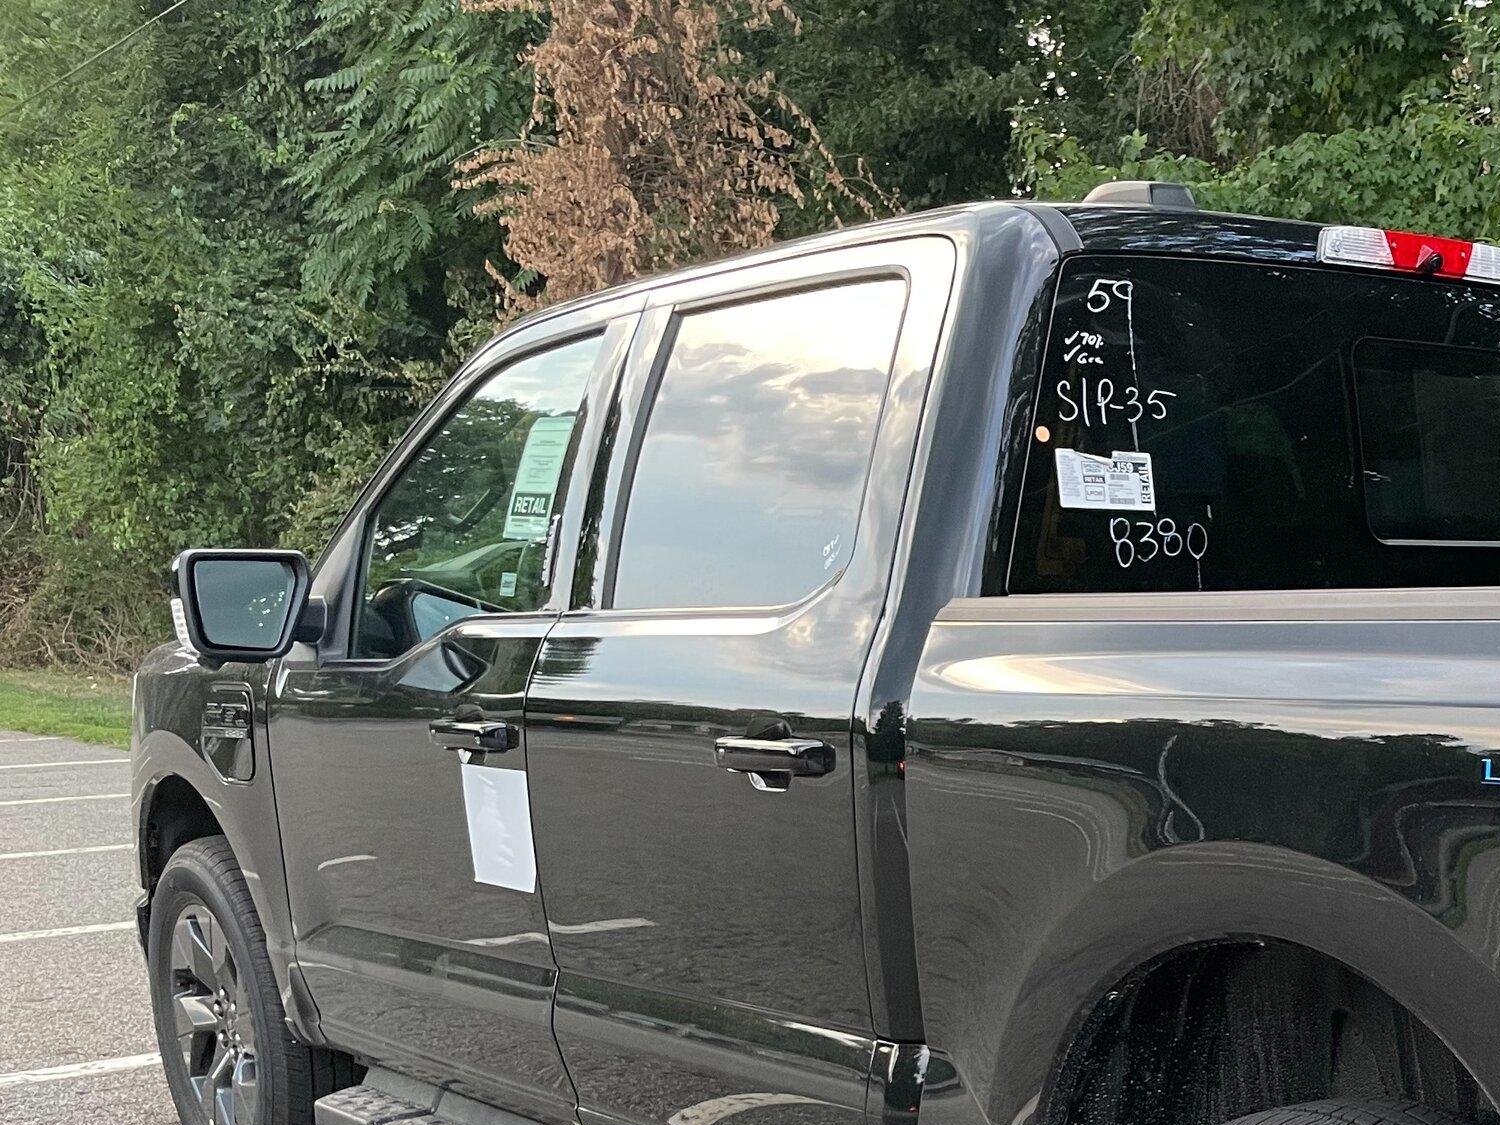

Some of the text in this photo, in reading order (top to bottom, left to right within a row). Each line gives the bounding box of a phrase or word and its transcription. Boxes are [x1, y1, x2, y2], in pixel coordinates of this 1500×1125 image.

[1087, 278, 1134, 321] 59
[513, 494, 549, 515] RETAIL
[1138, 463, 1152, 504] RETAIL
[1110, 517, 1208, 568] 8380
